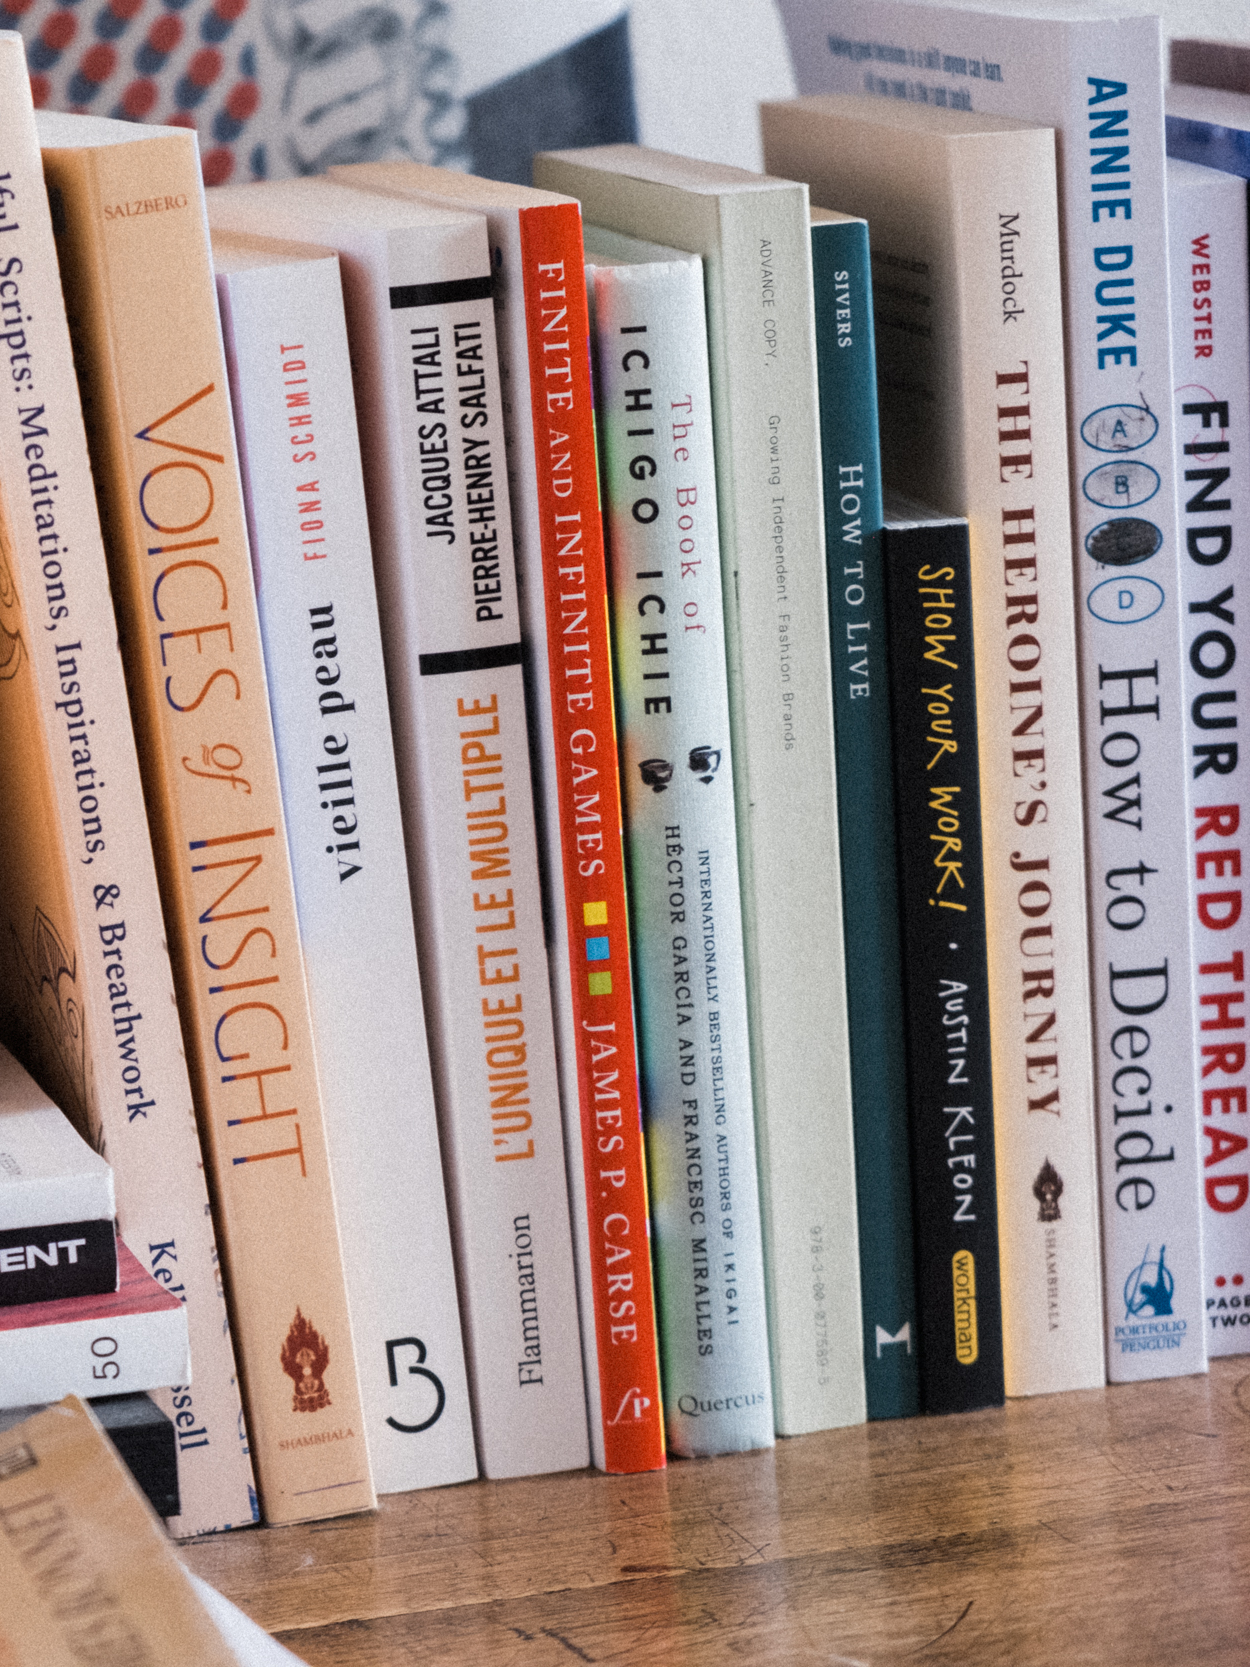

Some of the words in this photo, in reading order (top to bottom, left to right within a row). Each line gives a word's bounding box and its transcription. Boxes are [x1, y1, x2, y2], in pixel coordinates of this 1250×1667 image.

[1087, 76, 1132, 222] ANNIE
[103, 194, 188, 221] SALZBERG
[759, 238, 775, 308] ADVANCE
[834, 270, 852, 349] SIVERS
[999, 212, 1024, 324] Murdock
[1093, 245, 1137, 370] DUKE
[1191, 234, 1213, 359] WEBSTER
[410, 326, 446, 415] ATTALI
[453, 321, 489, 428] SALFATI
[538, 259, 574, 415] FINITE
[280, 342, 317, 463] SCHMIDT
[620, 325, 660, 525] ICHIGO
[670, 394, 694, 463] The
[768, 414, 783, 485] Growing
[995, 360, 1033, 483] THE
[1111, 419, 1127, 439] A
[418, 424, 456, 546] JACQUES
[549, 429, 573, 499] AND
[839, 463, 864, 545] HOW
[1114, 475, 1129, 494] B
[1182, 401, 1232, 566] FIND
[17, 403, 69, 632] Meditations,
[133, 382, 241, 713] VOICES
[296, 480, 328, 562] FIONA
[461, 438, 503, 622] PIERRE-HENRY
[675, 486, 701, 579] Book
[772, 496, 787, 602] Independent
[555, 510, 594, 714] INFINITE
[683, 601, 706, 635] of
[844, 560, 865, 606] TO
[918, 564, 958, 669] SHOW
[1117, 590, 1134, 609] D
[309, 601, 357, 717] peau
[636, 570, 672, 716] ICHIE
[779, 614, 791, 683] Fashion
[846, 620, 871, 700] LIVE
[1188, 585, 1238, 779] YOUR
[54, 640, 106, 865] Inspirations,
[181, 743, 252, 794] of
[782, 692, 794, 751] Brands
[921, 683, 958, 770] YOUR
[1099, 660, 1160, 831] How
[316, 732, 364, 884] vieille
[457, 693, 512, 881] MULTIPLE
[569, 728, 605, 878] GAMES
[93, 883, 121, 911] &
[665, 825, 686, 925] HÉCTOR
[928, 786, 967, 912] WORK!
[1105, 860, 1159, 931] to
[1195, 804, 1242, 930] RED
[472, 888, 516, 934] LE
[698, 849, 719, 1004] INTERNATIONALLY
[189, 827, 307, 1177] INSIGHT
[476, 944, 521, 987] ET
[672, 935, 695, 1027] GARCÍA
[1010, 851, 1061, 1118] JOURNEY
[99, 919, 156, 1123] Breathwork
[678, 1037, 696, 1087] AND
[708, 1010, 726, 1127] BESTSELLING
[938, 978, 970, 1084] AUSTIN
[481, 993, 536, 1163] L'UNIQUE
[583, 1020, 625, 1153] JAMES
[1109, 957, 1175, 1212] Decide
[1199, 951, 1250, 1214] THREAD
[601, 1168, 626, 1198] P.
[682, 1098, 706, 1226] FRANCESC
[716, 1133, 732, 1216] AUTHORS
[942, 1106, 976, 1222] KLEON
[603, 1213, 638, 1345] CARSE
[721, 1217, 734, 1240] OF
[1045, 1228, 1059, 1332] SHAMBHALA
[509, 1213, 543, 1389] Flammarion
[692, 1238, 713, 1357] MIRALLES
[724, 1251, 739, 1325] IKIGAI
[954, 1254, 976, 1359] workman
[1115, 1320, 1187, 1337] PORTFOLIO
[90, 1336, 120, 1380] 50
[1121, 1336, 1181, 1353] PENGUIN
[278, 1428, 355, 1451] SHAMBHALA
[678, 1392, 765, 1417] Quercus
